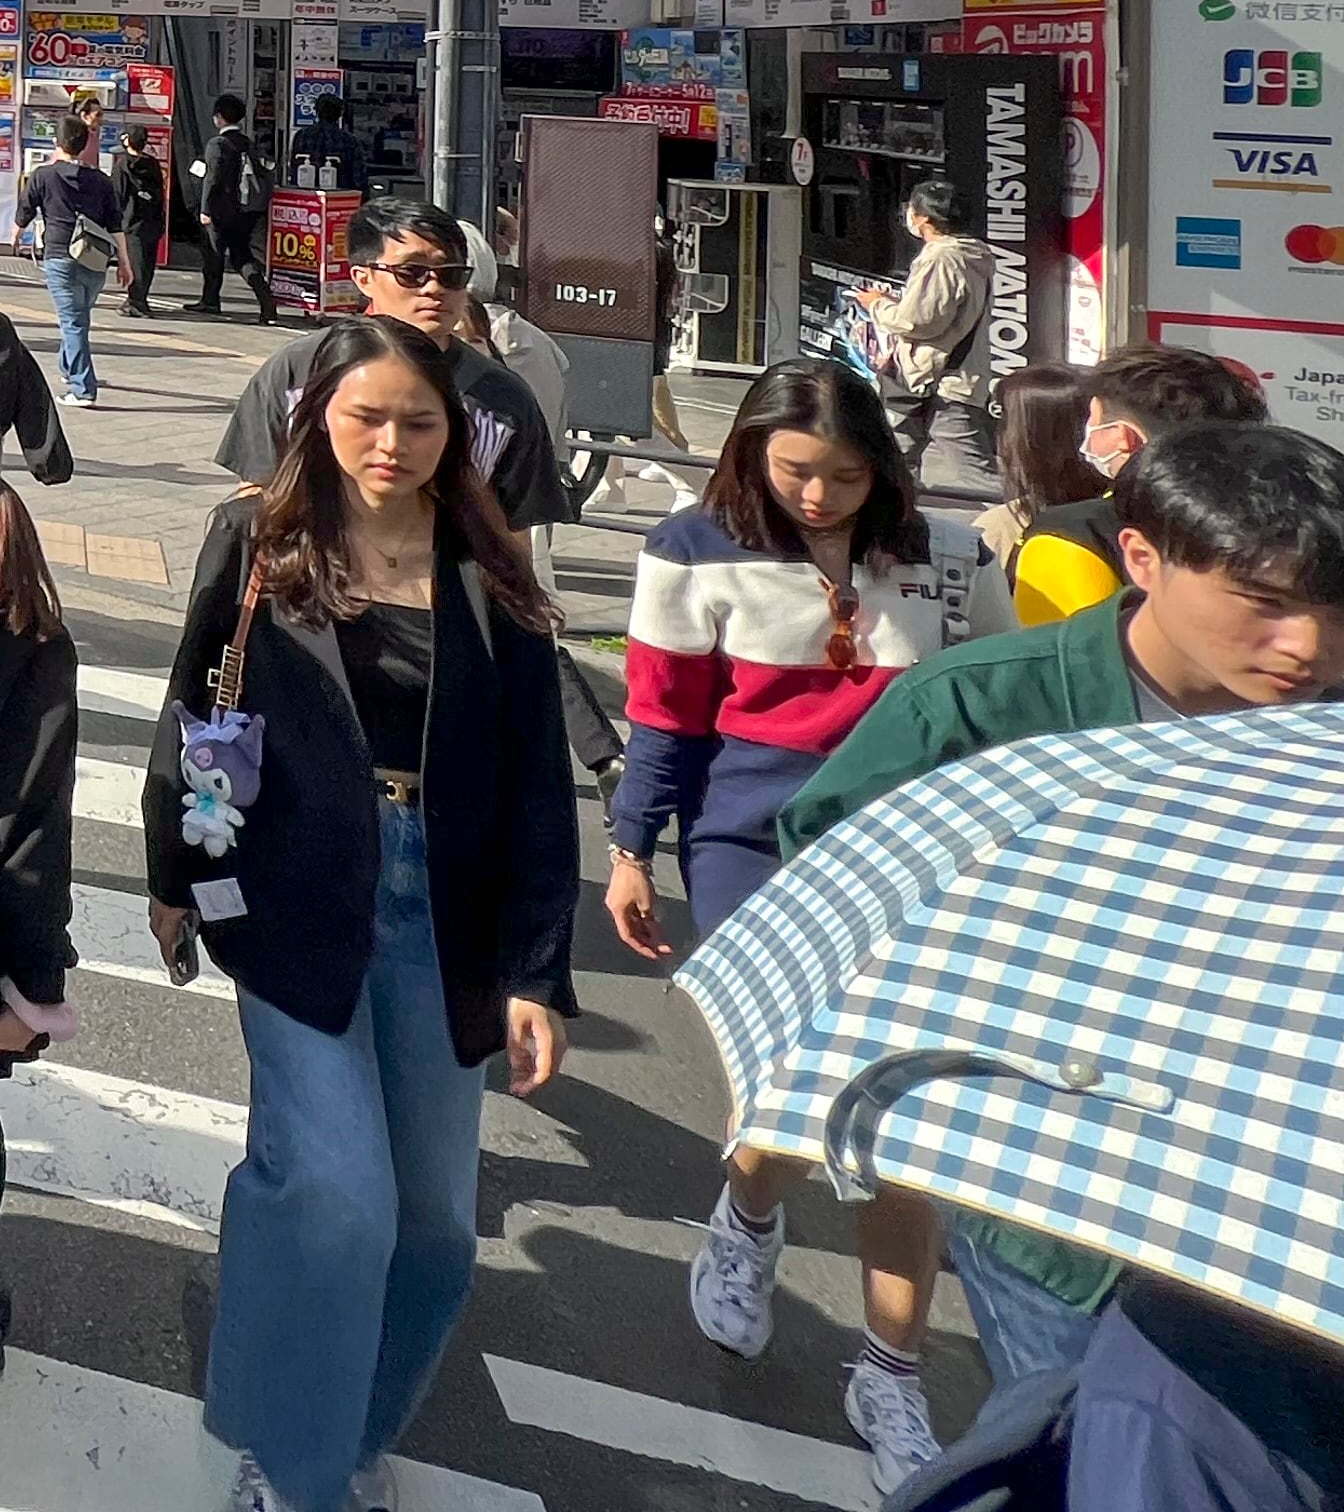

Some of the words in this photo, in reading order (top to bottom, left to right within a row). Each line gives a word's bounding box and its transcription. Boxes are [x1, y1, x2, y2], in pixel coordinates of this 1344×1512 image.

[1013, 21, 1093, 45] ビックカメラ
[1223, 48, 1323, 108] JCB
[985, 83, 1026, 242] TAMASHII
[1224, 147, 1320, 177] VISA
[555, 283, 617, 308] 103-17
